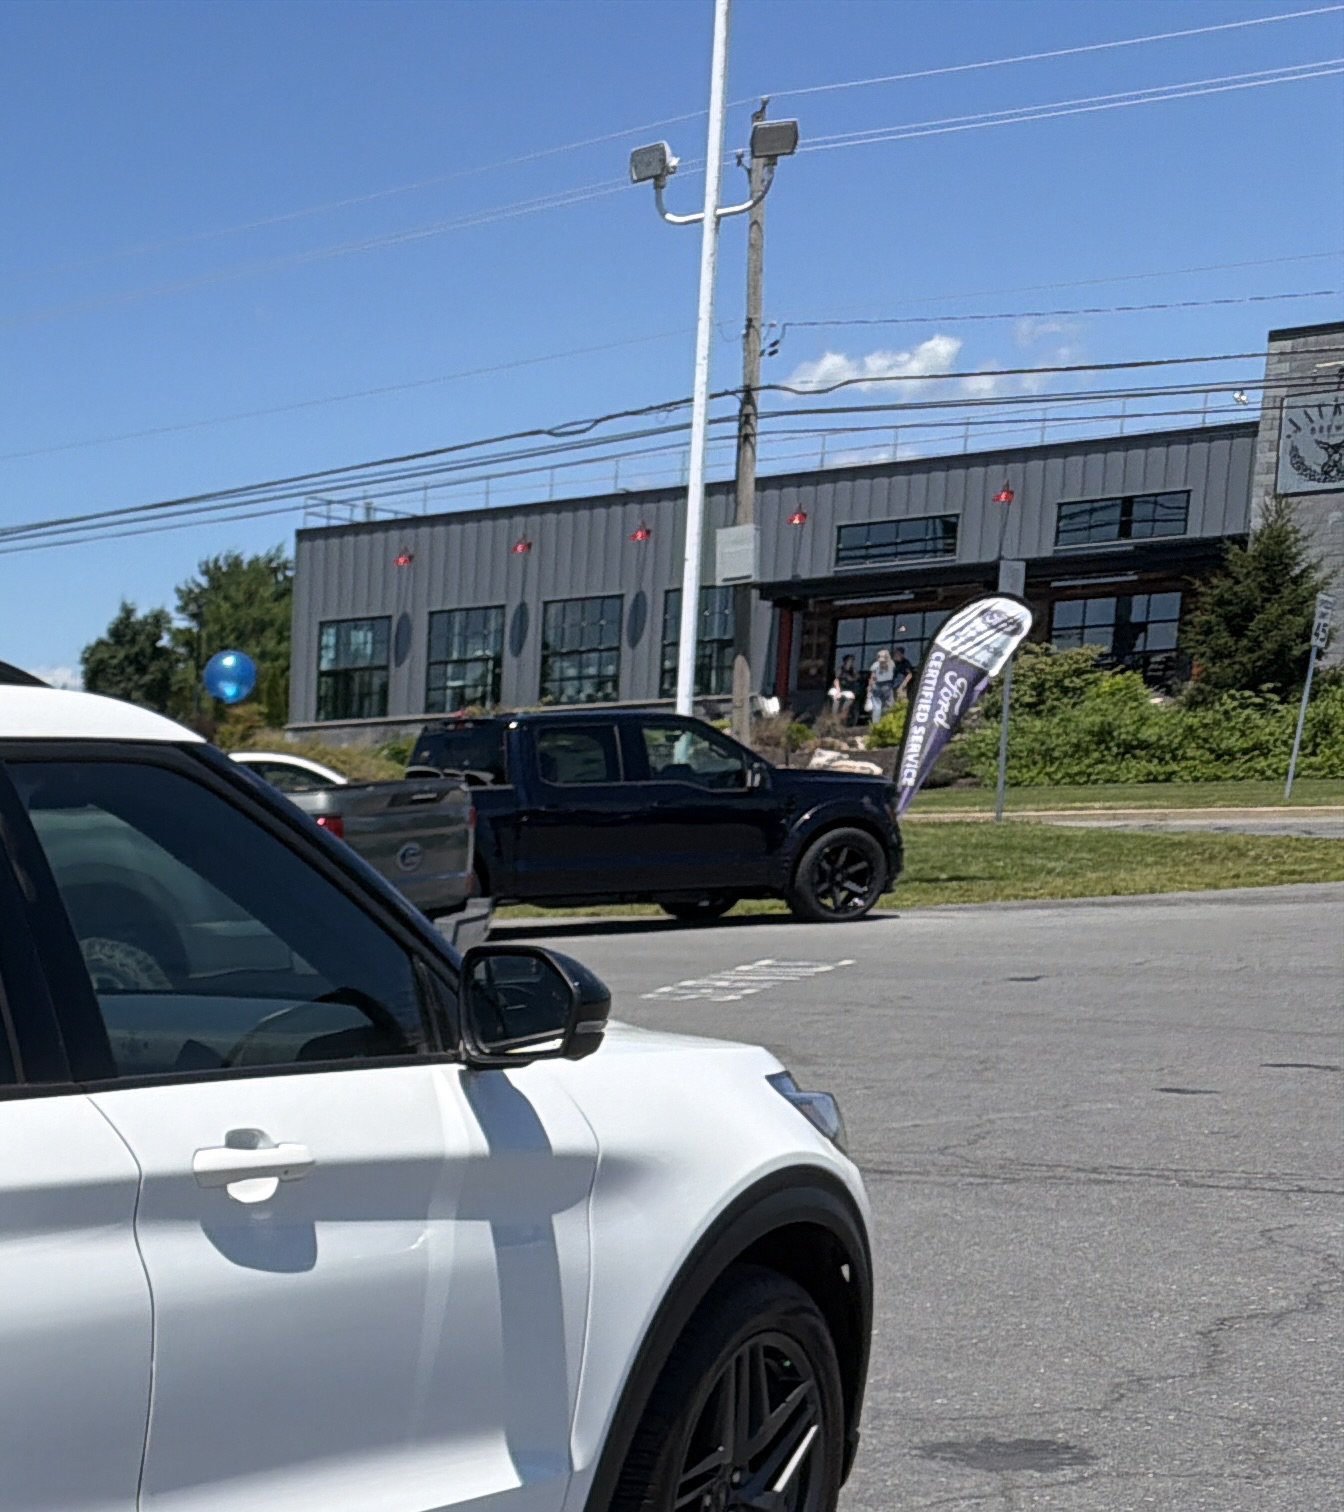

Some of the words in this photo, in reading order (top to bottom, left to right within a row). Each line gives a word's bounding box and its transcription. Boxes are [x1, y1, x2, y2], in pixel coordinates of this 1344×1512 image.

[914, 651, 946, 723] CERTIFIED
[933, 671, 968, 730] Ford
[901, 725, 926, 787] SERVICE
